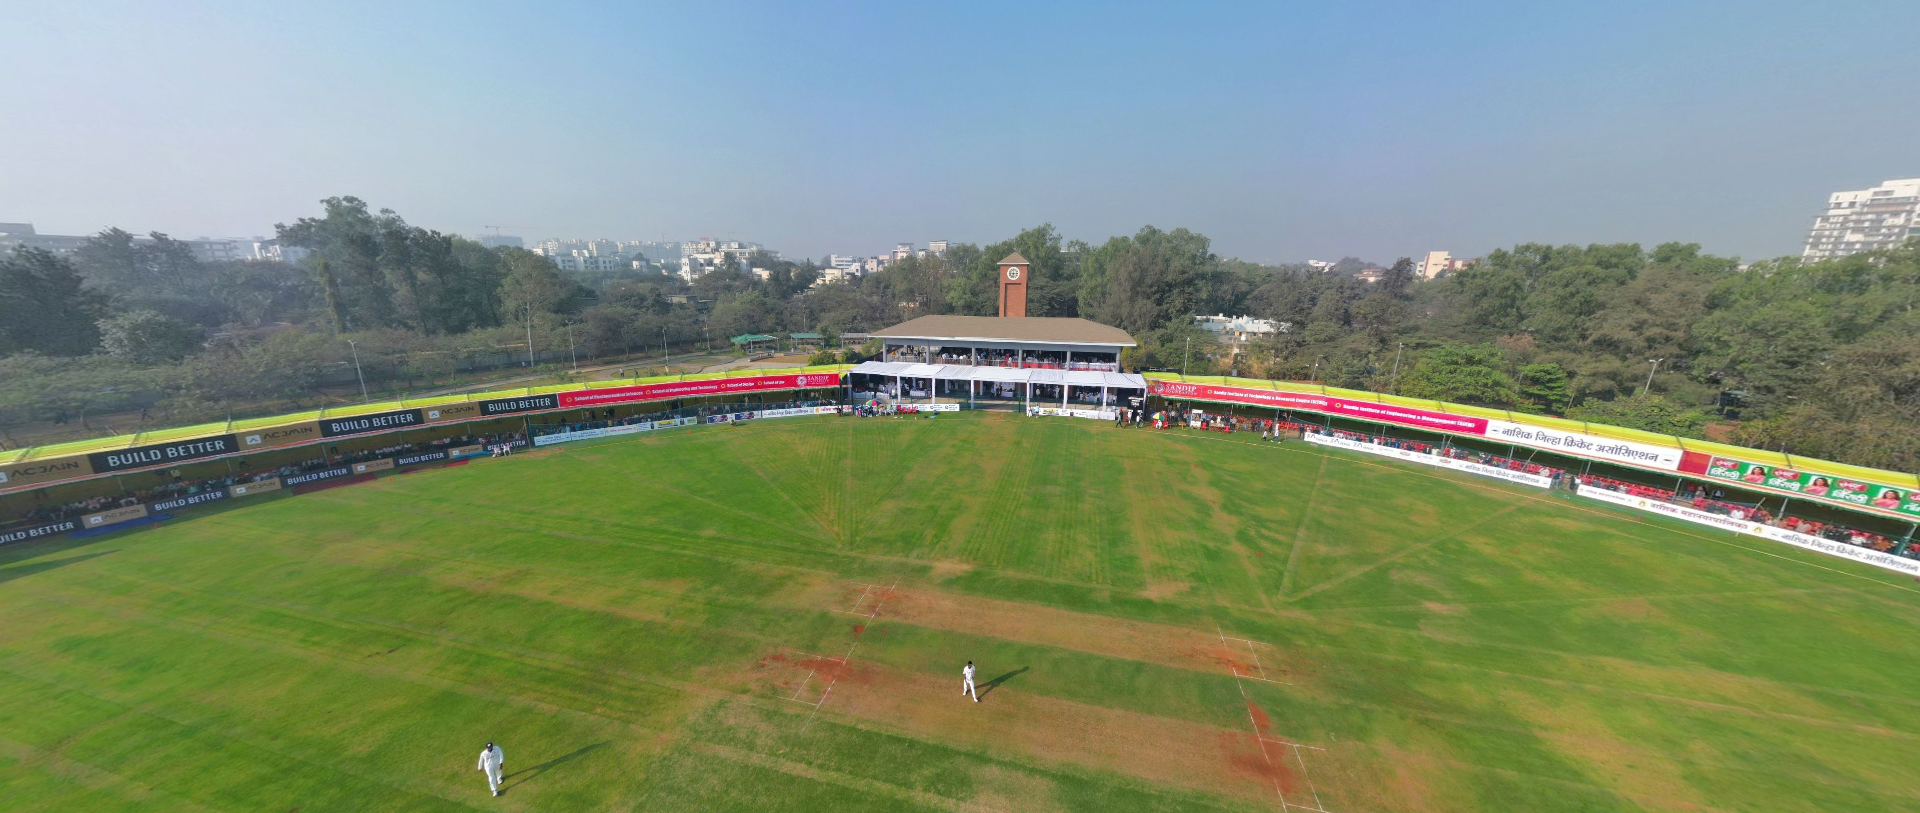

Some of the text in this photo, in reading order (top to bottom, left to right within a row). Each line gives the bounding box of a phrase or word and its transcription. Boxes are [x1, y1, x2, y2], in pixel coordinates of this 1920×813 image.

[1165, 383, 1197, 392] SANDIP
[488, 397, 551, 412] BUILD BETTER
[332, 413, 414, 433] BUILD BETTER
[1502, 427, 1533, 440] नाशिक
[1535, 431, 1561, 446] जिल्हा
[1563, 436, 1594, 451] क्रिकेट
[107, 440, 226, 467] BUILD BETTER
[399, 452, 444, 465] BUILD BETTER
[319, 468, 348, 479] BETTER
[155, 491, 223, 511] BUILD BETTER
[29, 521, 74, 537] BETTER
